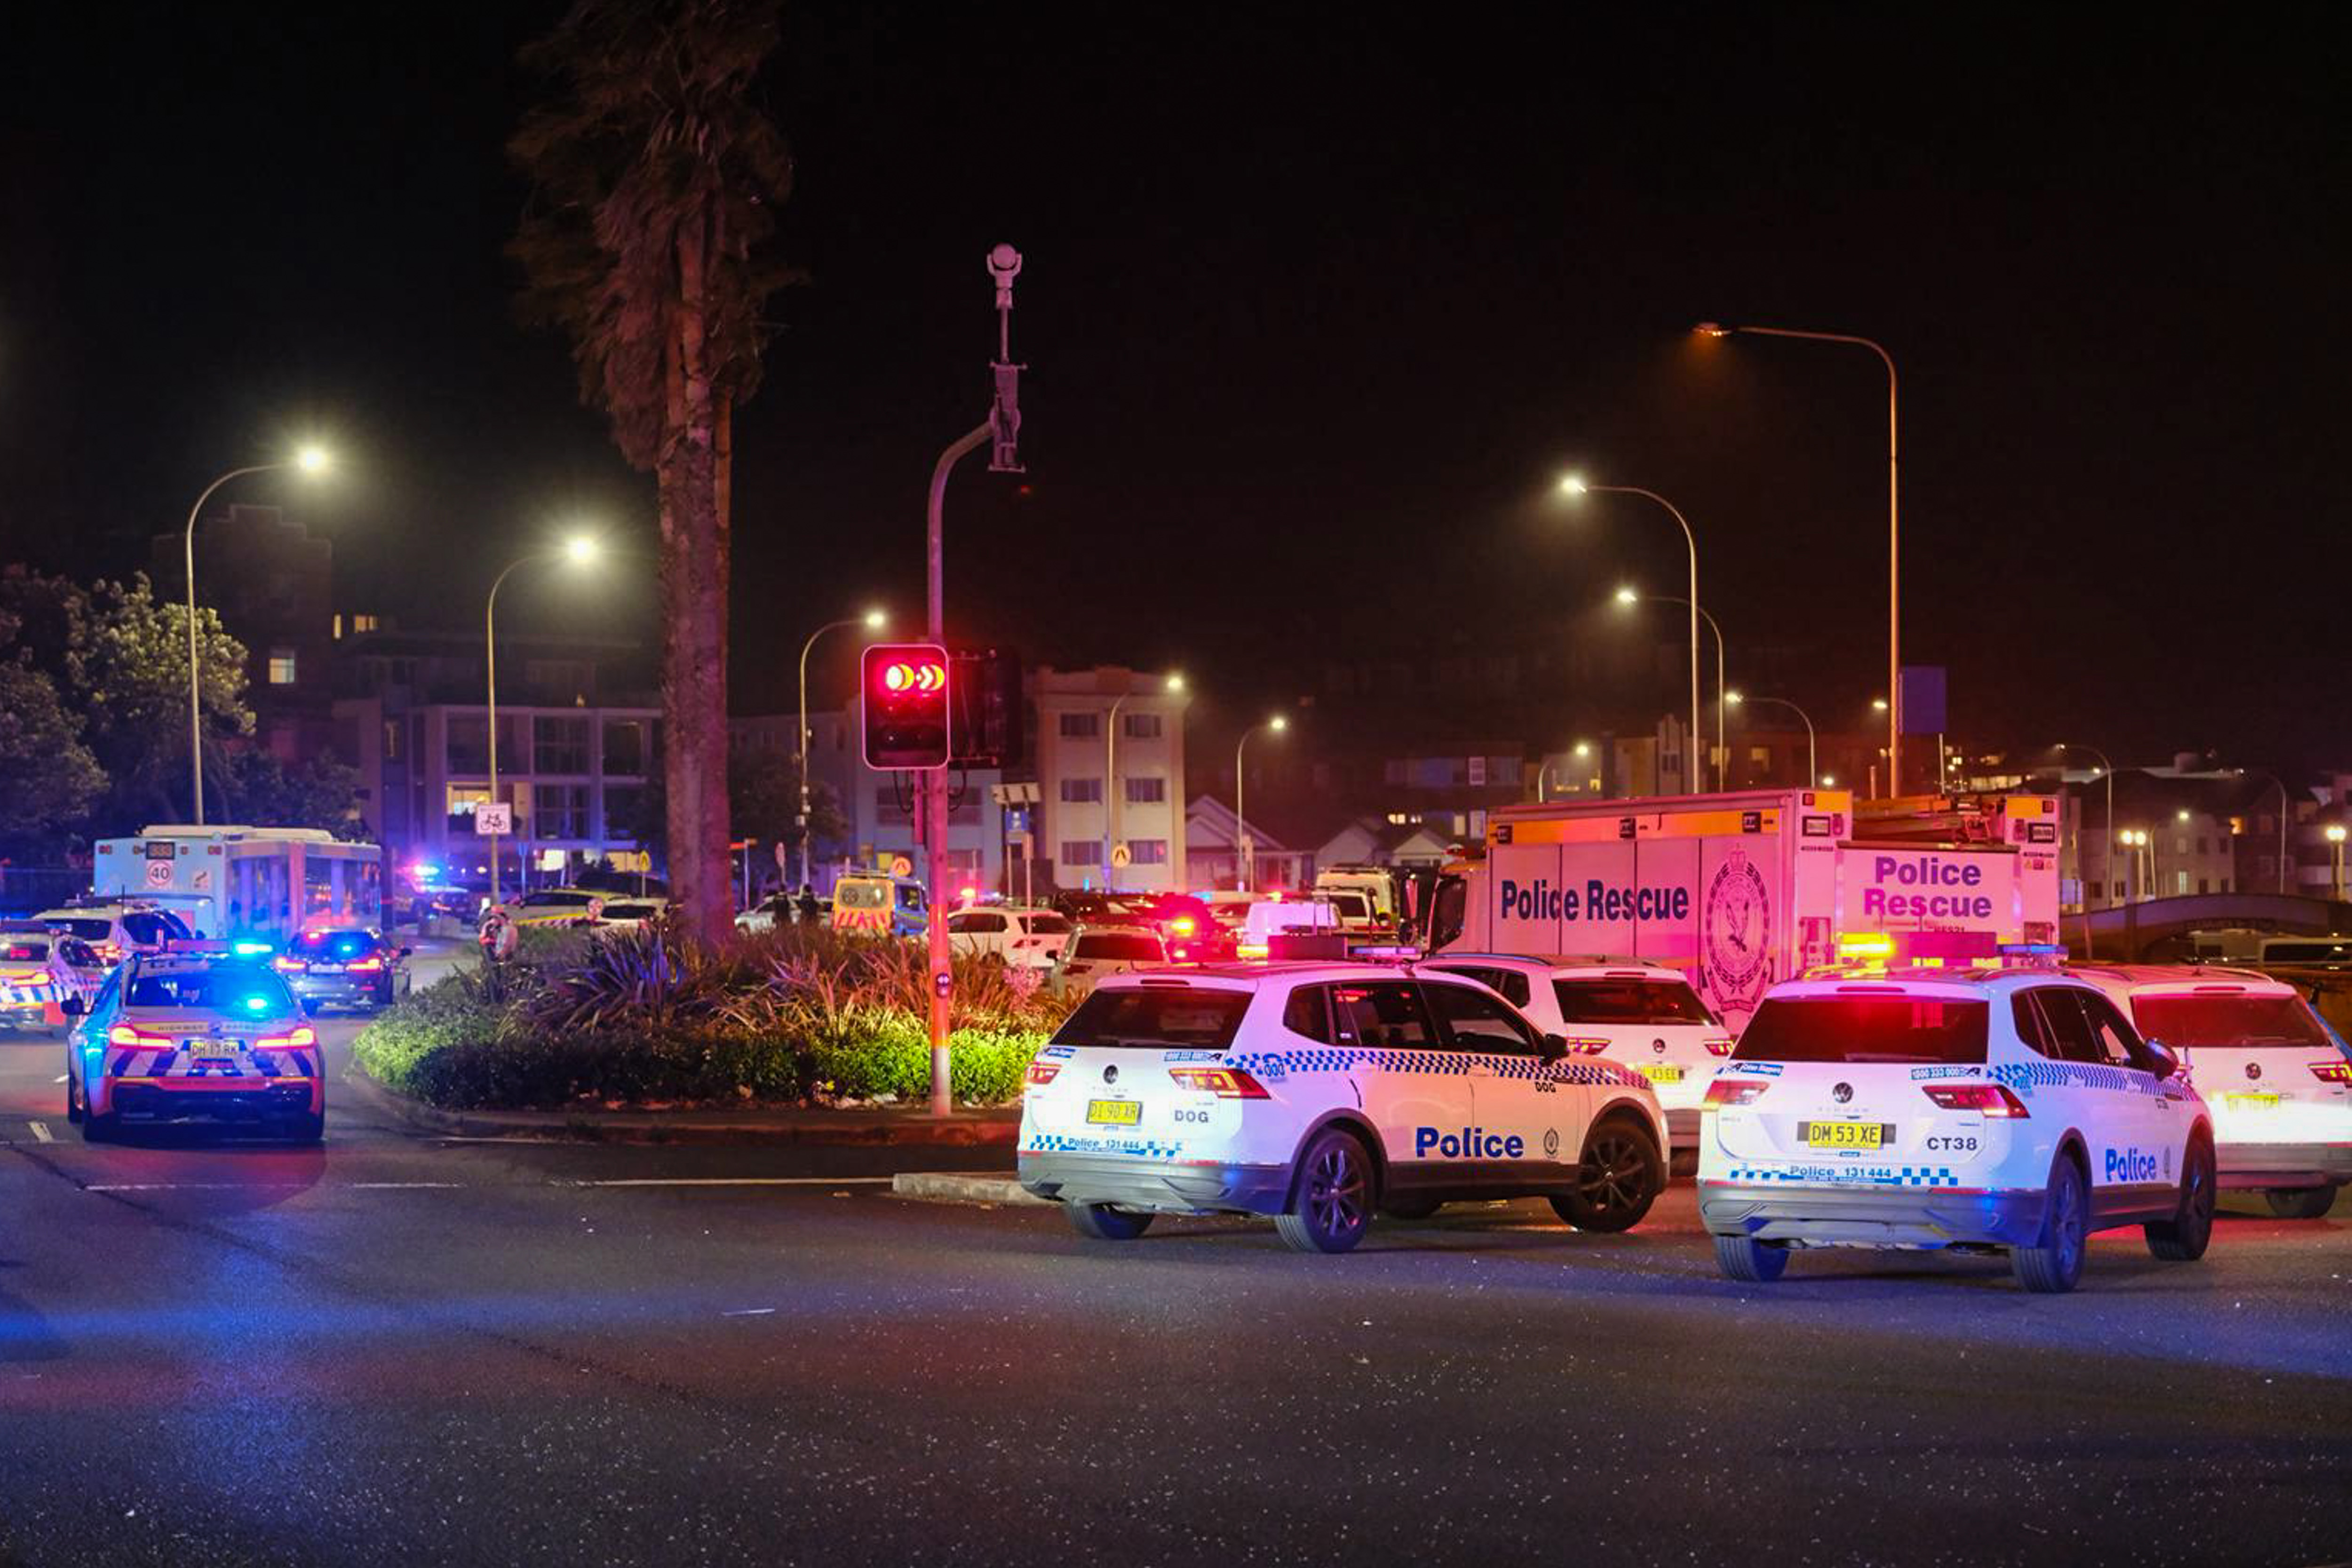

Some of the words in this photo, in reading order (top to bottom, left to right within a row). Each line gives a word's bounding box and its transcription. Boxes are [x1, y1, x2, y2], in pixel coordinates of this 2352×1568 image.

[152, 867, 169, 880] 40
[1875, 856, 1981, 886] Police
[1502, 879, 1579, 921] Police
[1587, 879, 1688, 921] Rescue
[1864, 888, 1992, 917] Rescue
[1175, 1110, 1208, 1123] DOG
[1068, 1138, 1099, 1148] Police
[1416, 1127, 1524, 1158] Police
[1812, 1125, 1832, 1141] DM
[1836, 1126, 1855, 1142] 53
[1860, 1126, 1878, 1143] XE
[1927, 1137, 1977, 1150] CT38
[1789, 1165, 1835, 1176] Police
[1845, 1168, 1865, 1176] 131
[1867, 1168, 1891, 1177] 444
[2106, 1148, 2156, 1182] Police
